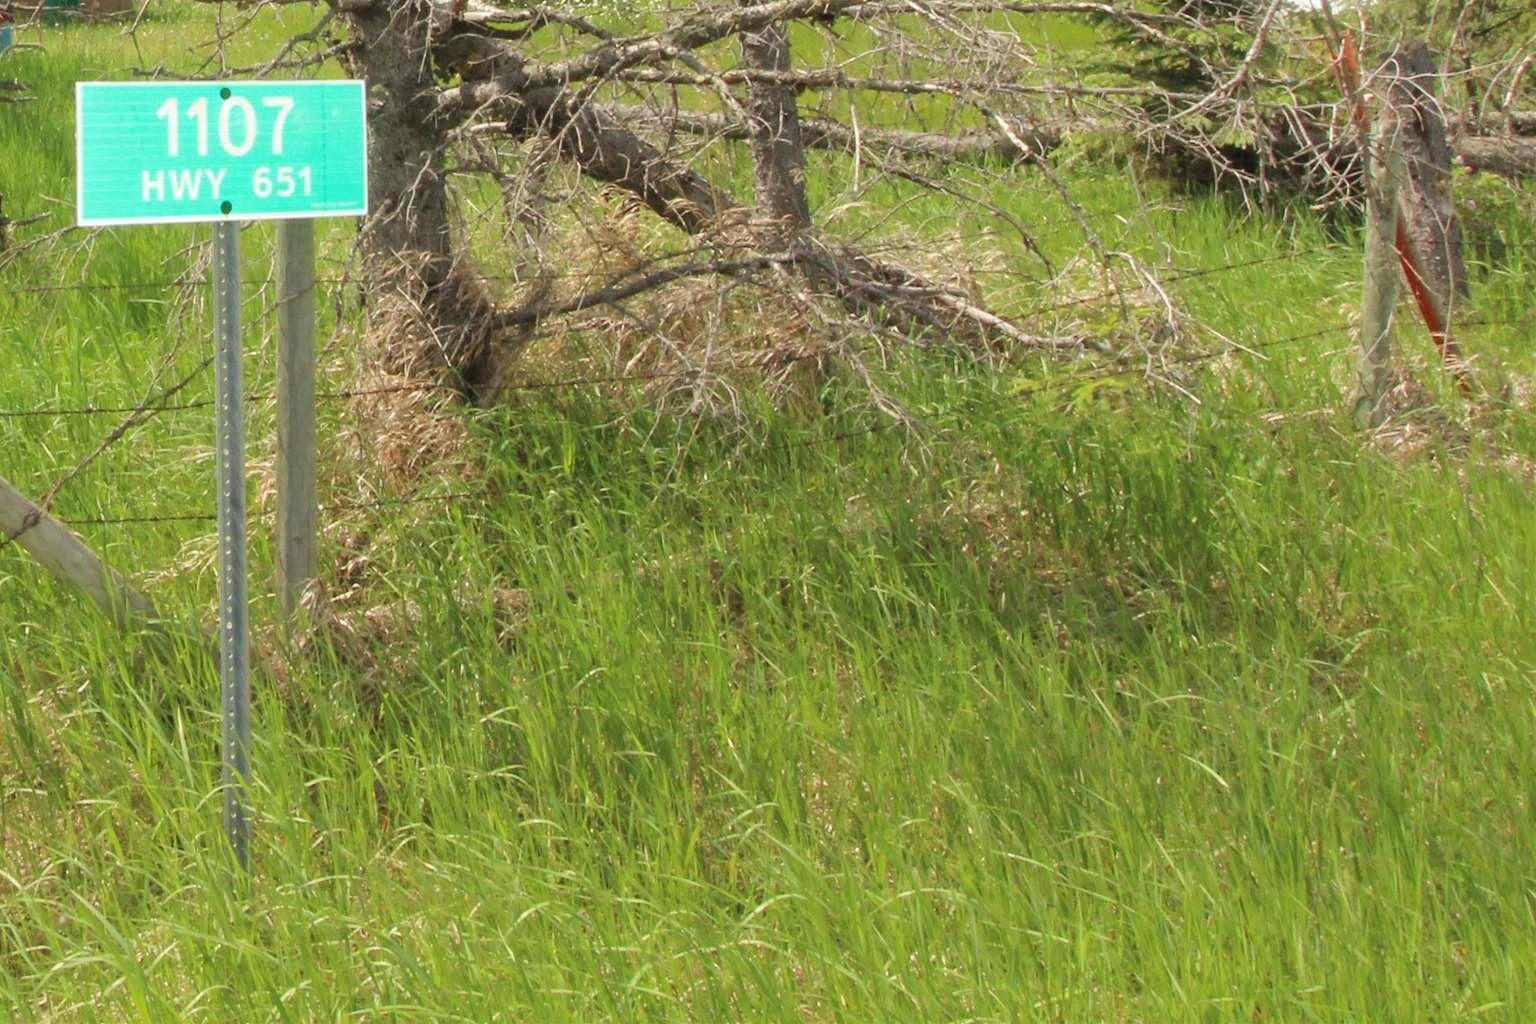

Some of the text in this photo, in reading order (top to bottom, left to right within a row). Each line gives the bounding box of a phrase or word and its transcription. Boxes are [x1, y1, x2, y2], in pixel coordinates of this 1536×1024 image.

[155, 96, 295, 157] 1107
[141, 165, 312, 202] HWY 651
